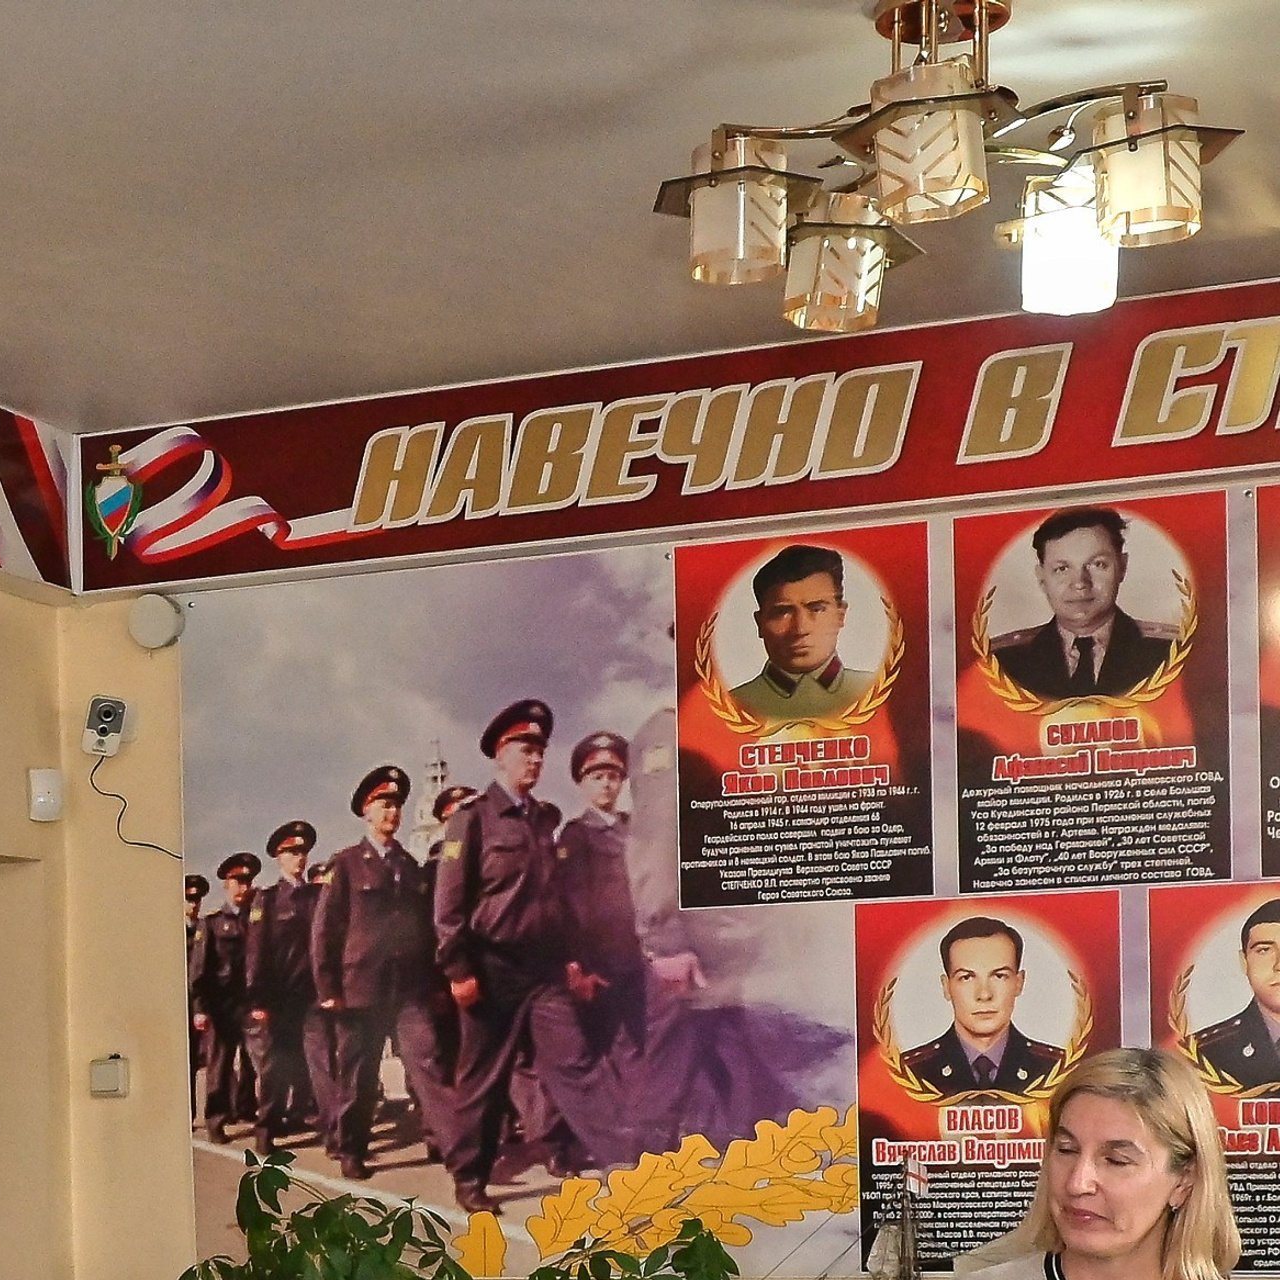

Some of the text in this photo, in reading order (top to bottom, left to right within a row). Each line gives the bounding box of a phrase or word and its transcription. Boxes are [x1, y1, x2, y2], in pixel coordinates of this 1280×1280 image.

[350, 316, 1280, 530] НАВЕЧНО В СТ
[1045, 717, 1141, 747] СУХАНОВ
[740, 735, 870, 768] СТЕПЧЕНКО
[992, 750, 1091, 784] Афанасий
[722, 765, 889, 796] Яков Павлович
[961, 771, 1224, 798] Дежурный помощник начальника Артемовского ГОВД,
[970, 794, 1216, 819] Уса Куединского района Пермской области, погиб
[977, 785, 1211, 807] майор Родился в 1926 г. в селе Большая
[975, 808, 1212, 831] 12 февраля 1975 года при исполнении служебных
[976, 829, 1042, 842] обязанностей
[1044, 830, 1049, 838] в
[1060, 828, 1099, 838] Артеме.
[1101, 824, 1156, 835] Награжден
[980, 831, 1206, 855] „За победу над Германией“, „30 лет Советской
[973, 856, 1005, 866] Армии
[1014, 852, 1051, 863] Флоту“,
[1053, 851, 1069, 862] „40
[1070, 851, 1086, 860] лет
[1088, 848, 1156, 859] Вооруженных
[1158, 847, 1176, 855] сил
[1177, 843, 1213, 853] СССР“,
[993, 856, 1193, 877] „За безупречную службу“ трех степеней.
[972, 867, 1215, 888] Навечно занесен в списки личного состава ГОВД.
[946, 1105, 1022, 1134] ВЛАСОВ
[936, 1230, 962, 1238] Власов
[962, 1229, 975, 1238] В.В.
